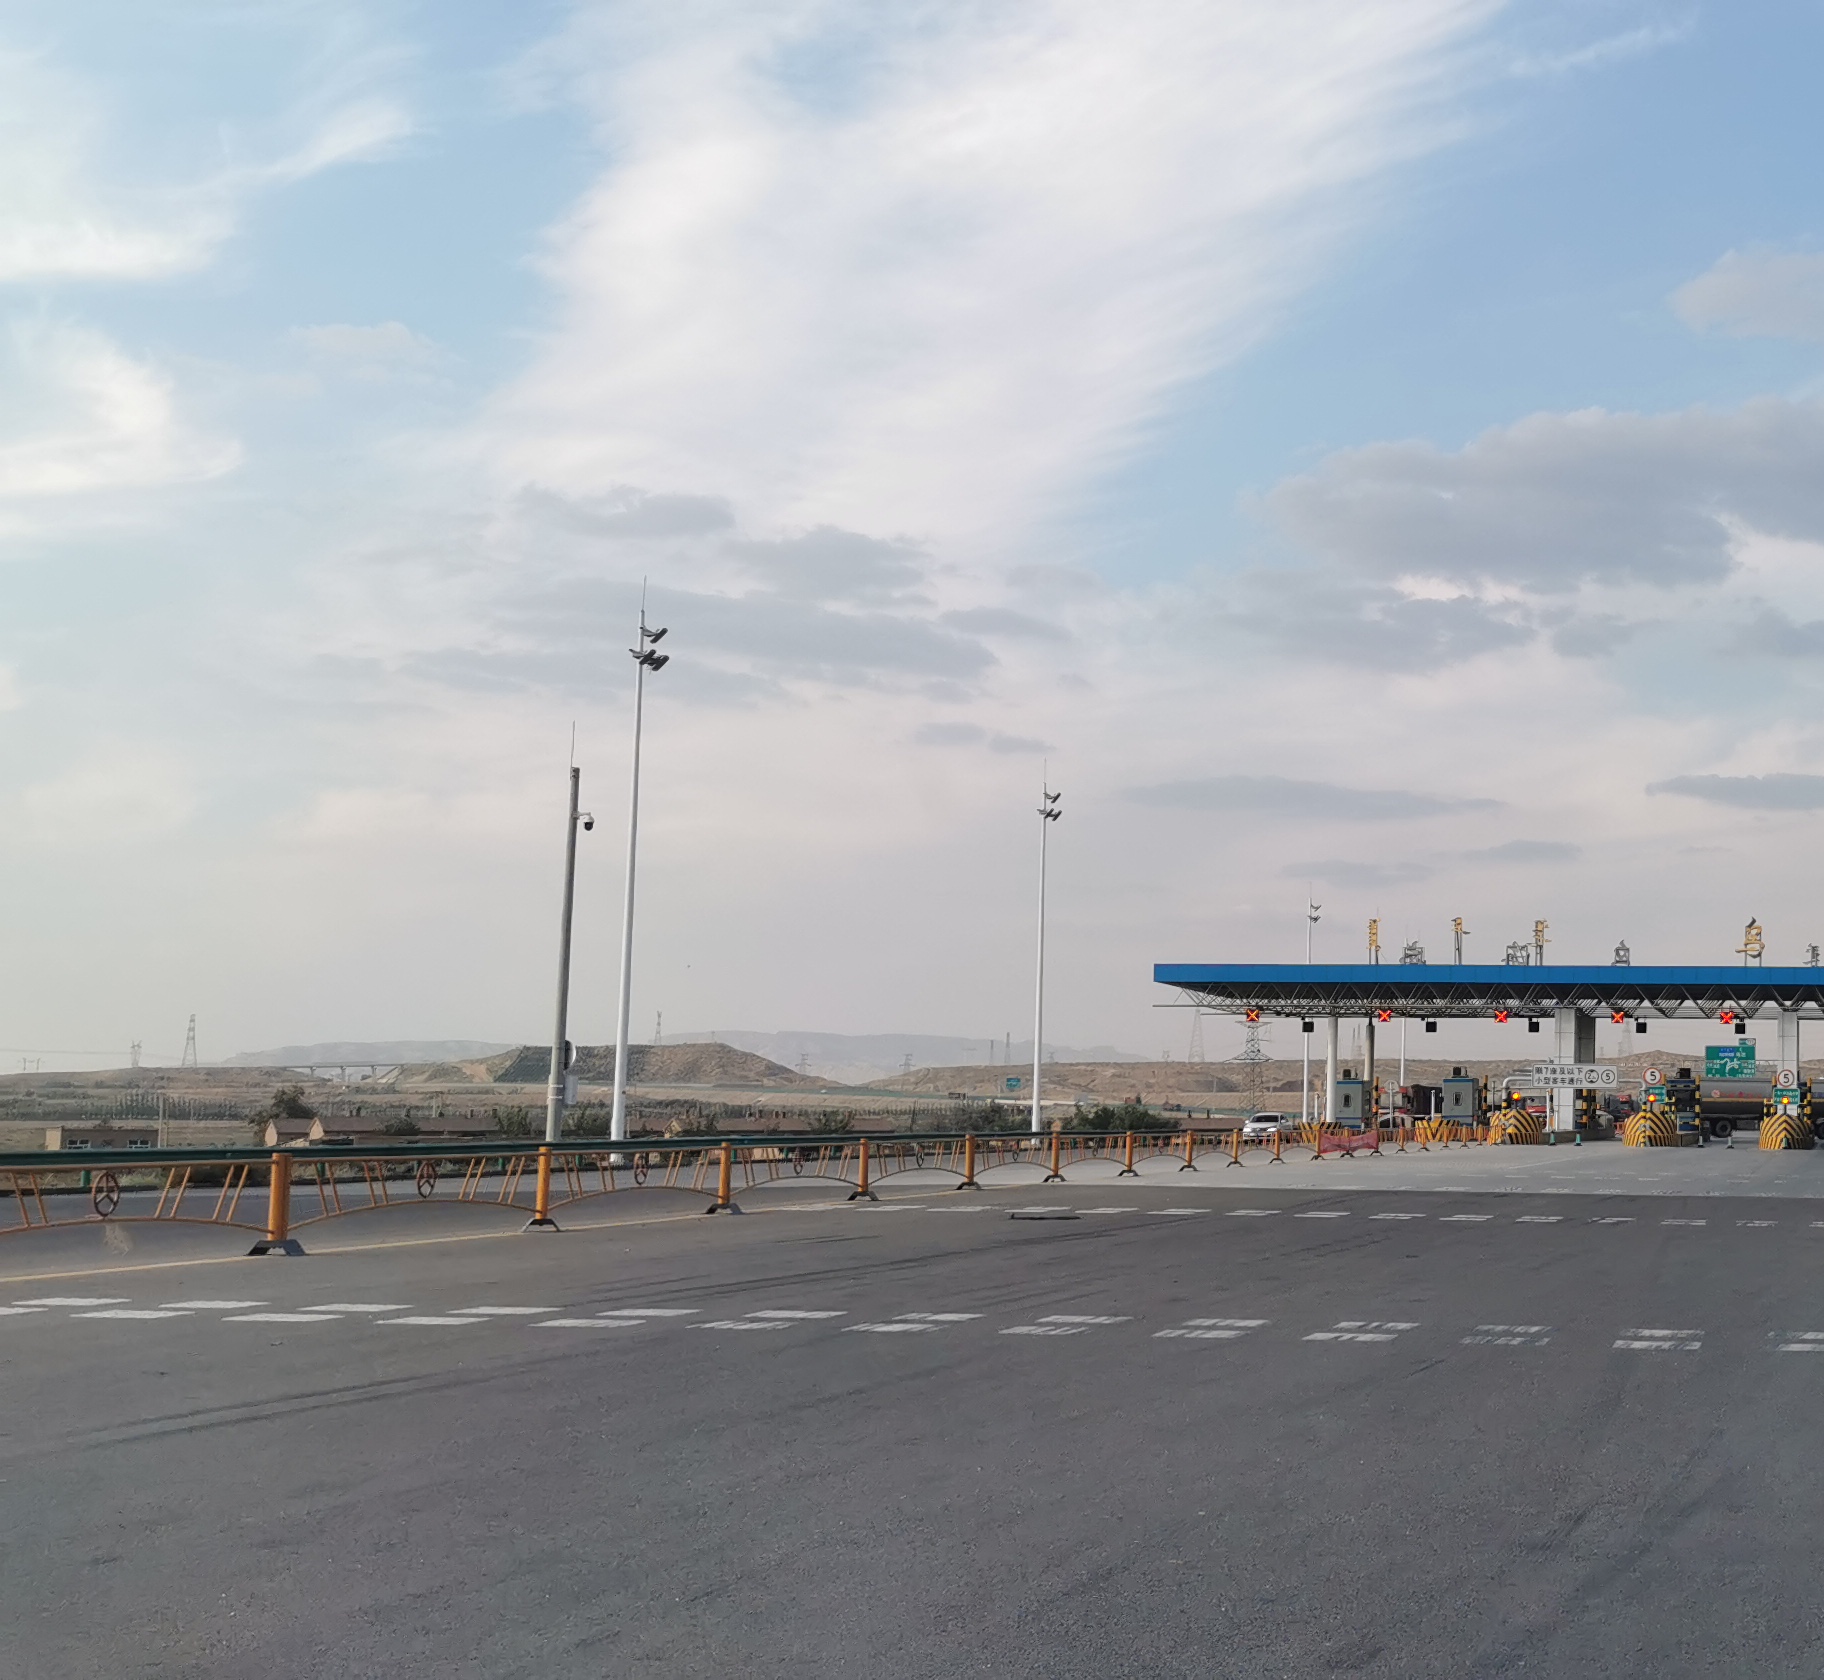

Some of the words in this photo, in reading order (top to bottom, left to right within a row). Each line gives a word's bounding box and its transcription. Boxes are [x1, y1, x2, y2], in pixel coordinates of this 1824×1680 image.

[1535, 1066, 1583, 1075] 限7座及以下
[1535, 1076, 1583, 1086] 小型客车通行
[1605, 1072, 1611, 1081] 5
[1650, 1071, 1656, 1081] 5
[1783, 1073, 1790, 1083] 5
